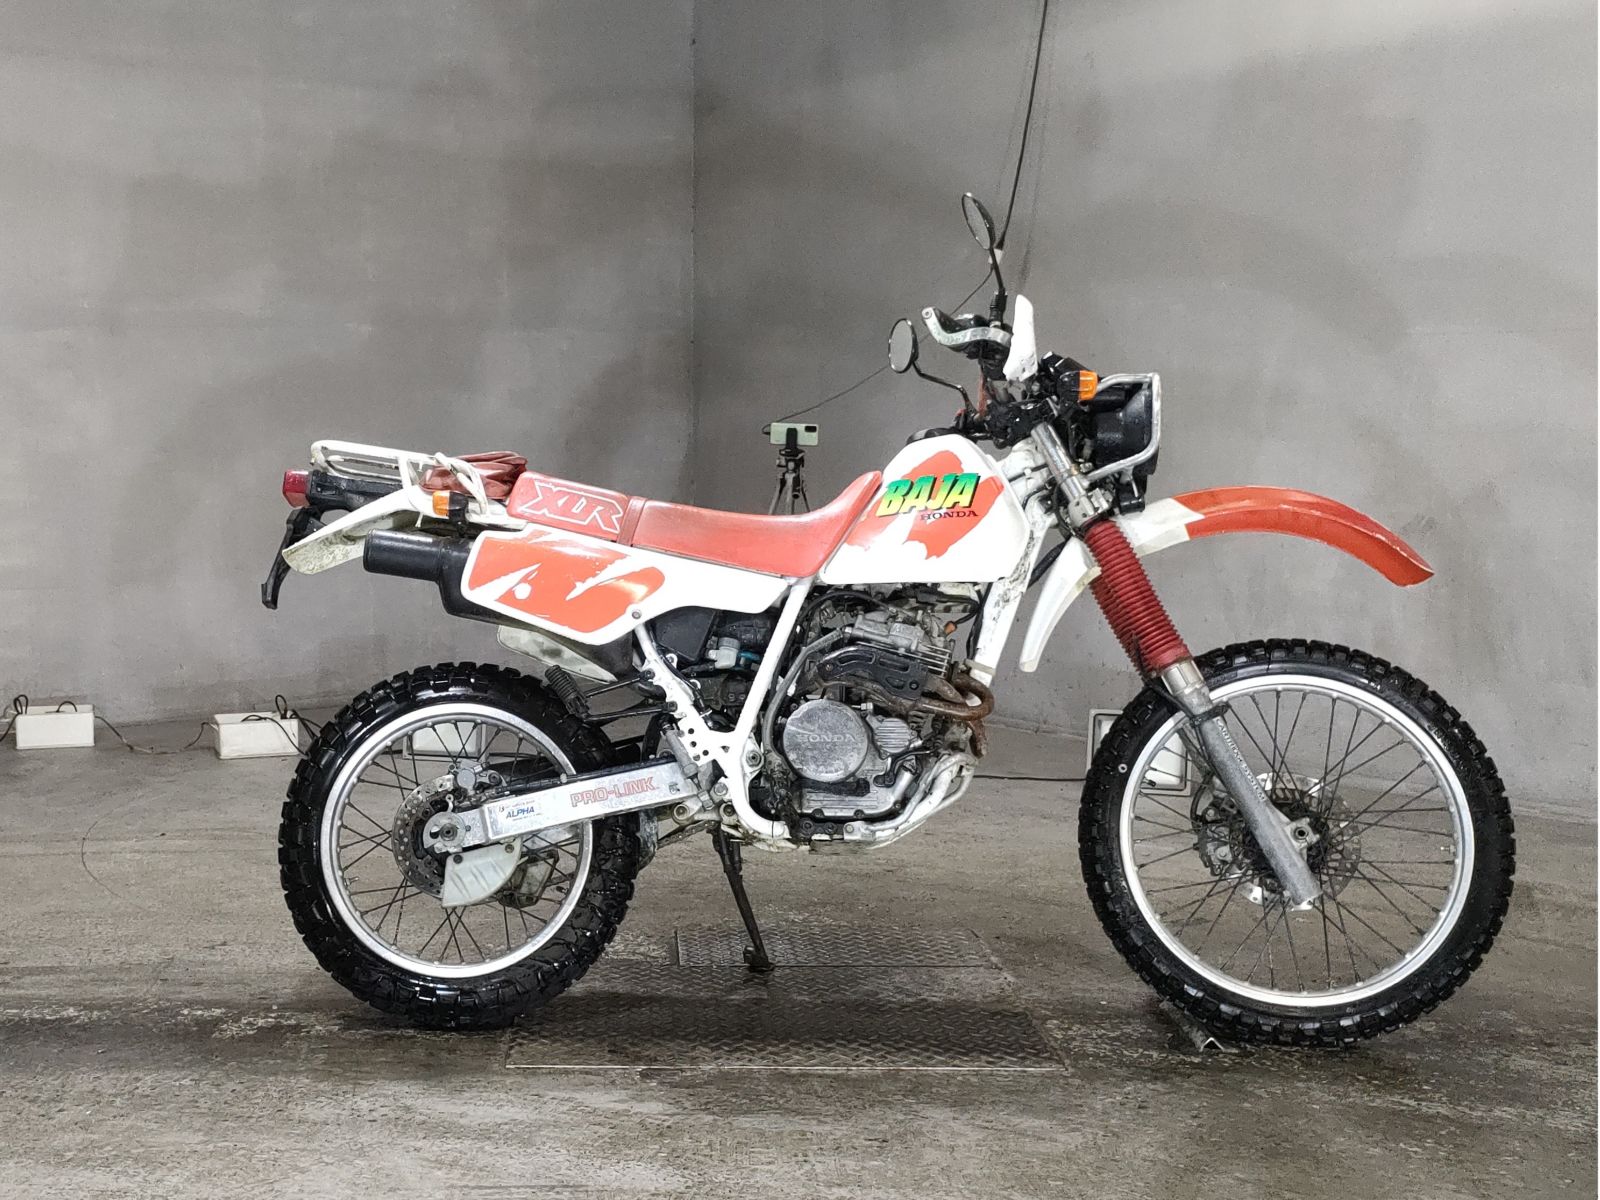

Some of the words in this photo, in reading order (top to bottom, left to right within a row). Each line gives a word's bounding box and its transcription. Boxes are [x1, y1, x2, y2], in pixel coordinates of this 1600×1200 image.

[875, 473, 980, 517] BAJA
[518, 480, 623, 533] XLR
[920, 510, 979, 521] HONDA
[796, 733, 857, 743] HONDA
[570, 777, 656, 807] PRO-LINK
[505, 806, 535, 819] ALPHA
